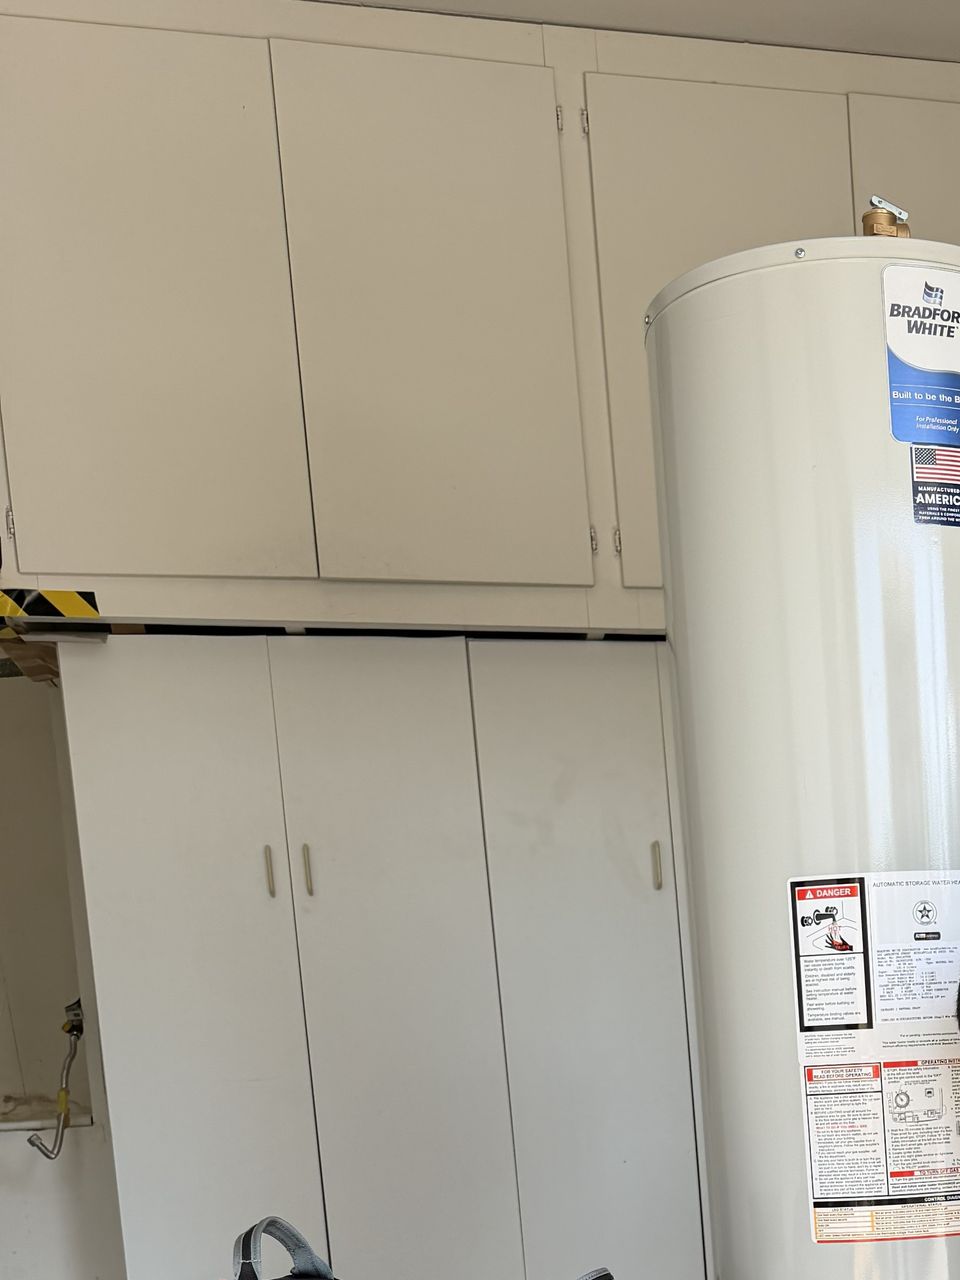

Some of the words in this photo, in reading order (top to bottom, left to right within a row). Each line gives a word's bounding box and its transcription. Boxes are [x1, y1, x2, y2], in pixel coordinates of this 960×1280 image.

[907, 320, 956, 338] WHITE
[892, 390, 912, 399] Built
[914, 392, 923, 400] to
[925, 392, 937, 400] be
[939, 394, 952, 402] the
[926, 416, 958, 425] Professional
[947, 425, 960, 434] Only
[918, 486, 960, 494] MANUFACTURED
[816, 888, 851, 897] DANGER
